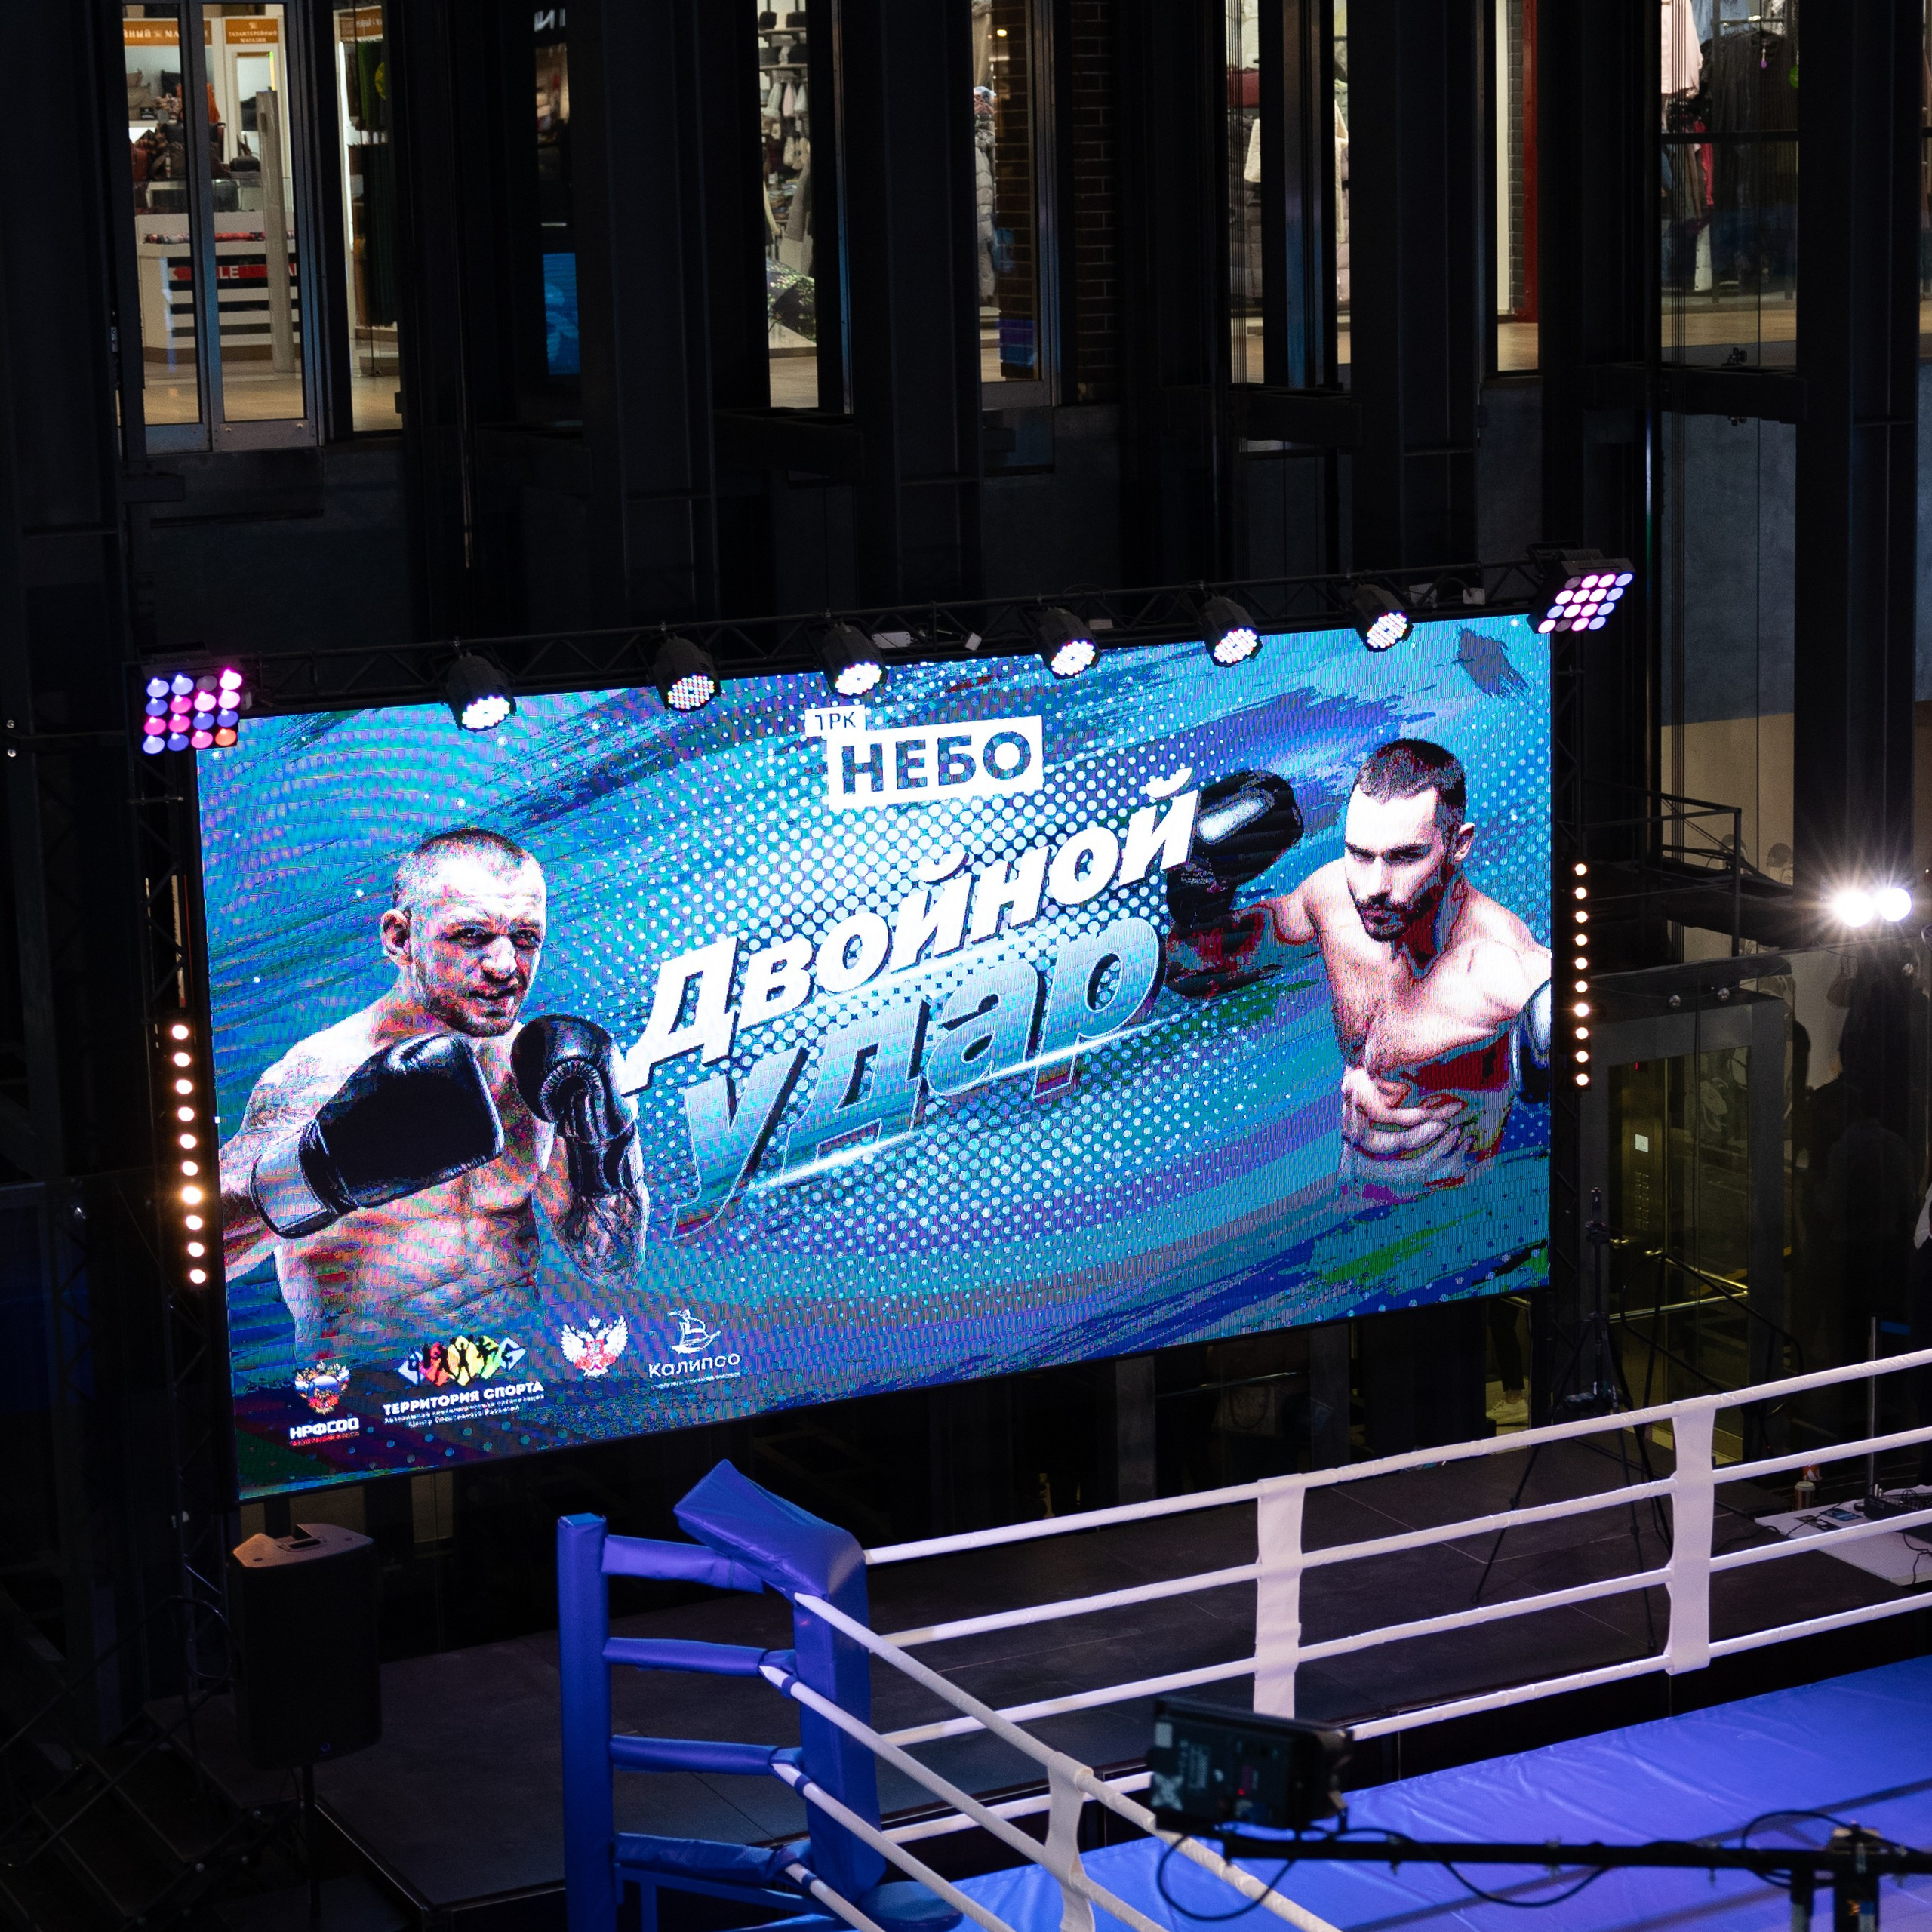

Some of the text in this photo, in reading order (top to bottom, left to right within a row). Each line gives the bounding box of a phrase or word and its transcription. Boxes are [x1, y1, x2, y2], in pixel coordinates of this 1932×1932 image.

[814, 711, 857, 731] ТРК
[841, 731, 1032, 795] НЕБО
[648, 1352, 741, 1379] Калипсо
[383, 1380, 545, 1416] ТЕРРИТОРИЯ СПОРТА
[289, 1417, 360, 1440] НРФСОО
